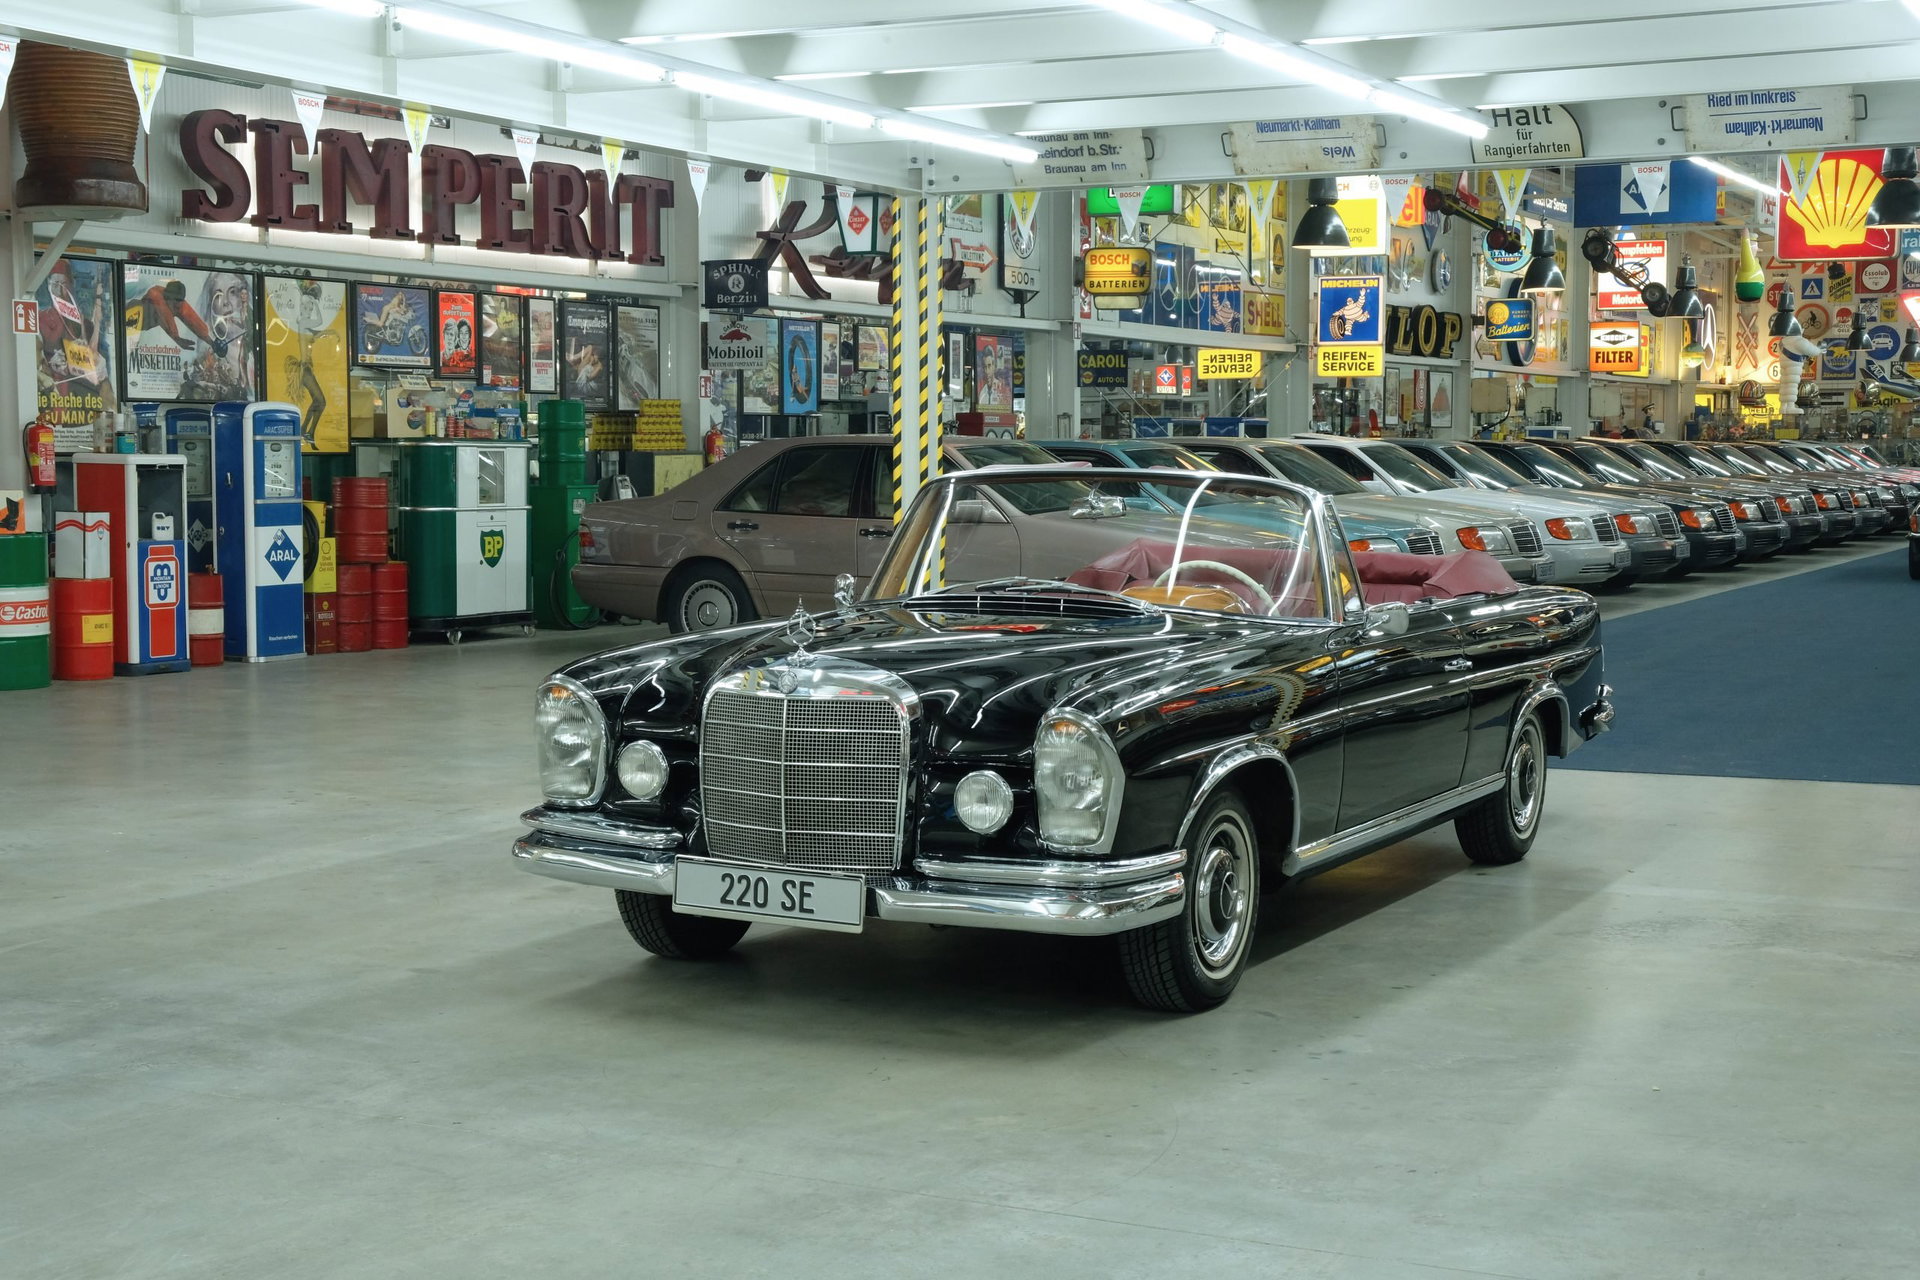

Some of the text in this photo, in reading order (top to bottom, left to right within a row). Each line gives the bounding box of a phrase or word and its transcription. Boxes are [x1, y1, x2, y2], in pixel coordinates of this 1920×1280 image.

[297, 97, 320, 108] BOSCH
[1708, 90, 1796, 108] Ried im Innkreis
[1492, 104, 1553, 127] Halt
[1073, 133, 1089, 142] am
[1516, 129, 1533, 140] für
[1037, 146, 1084, 159] eindorf
[1322, 146, 1355, 158] Wels
[1484, 141, 1571, 158] Rangierfahrten
[690, 165, 706, 175] BOSCH
[1044, 162, 1127, 174] Braunau am Inn
[1637, 165, 1663, 174] BOSCH
[179, 108, 675, 263] SEMPERIT
[1384, 178, 1408, 186] BOSCH
[838, 190, 852, 199] BOSCH
[1119, 190, 1141, 199] BOSCH
[1553, 198, 1568, 214] Service
[1089, 254, 1130, 266] BOSCH
[1089, 279, 1145, 288] BATTERIEN
[1322, 279, 1378, 288] MICHELIN
[1247, 299, 1282, 328] SHELL
[1488, 321, 1530, 338] Batterien
[708, 345, 764, 359] Mobiloil
[1323, 351, 1375, 361] REIFEN-
[1595, 350, 1633, 363] FILTER
[128, 349, 182, 374] MUSKETIER
[1079, 354, 1126, 368] CAROIL
[1323, 362, 1375, 371] SERVICE
[1772, 366, 1779, 377] 6
[1869, 363, 1883, 379] ANA
[51, 392, 83, 408] Rache
[85, 393, 103, 409] des
[61, 411, 85, 424] MAN
[484, 535, 504, 558] BP
[269, 549, 296, 562] ARAL
[15, 605, 49, 620] Castrol
[720, 873, 815, 914] 220 SE
